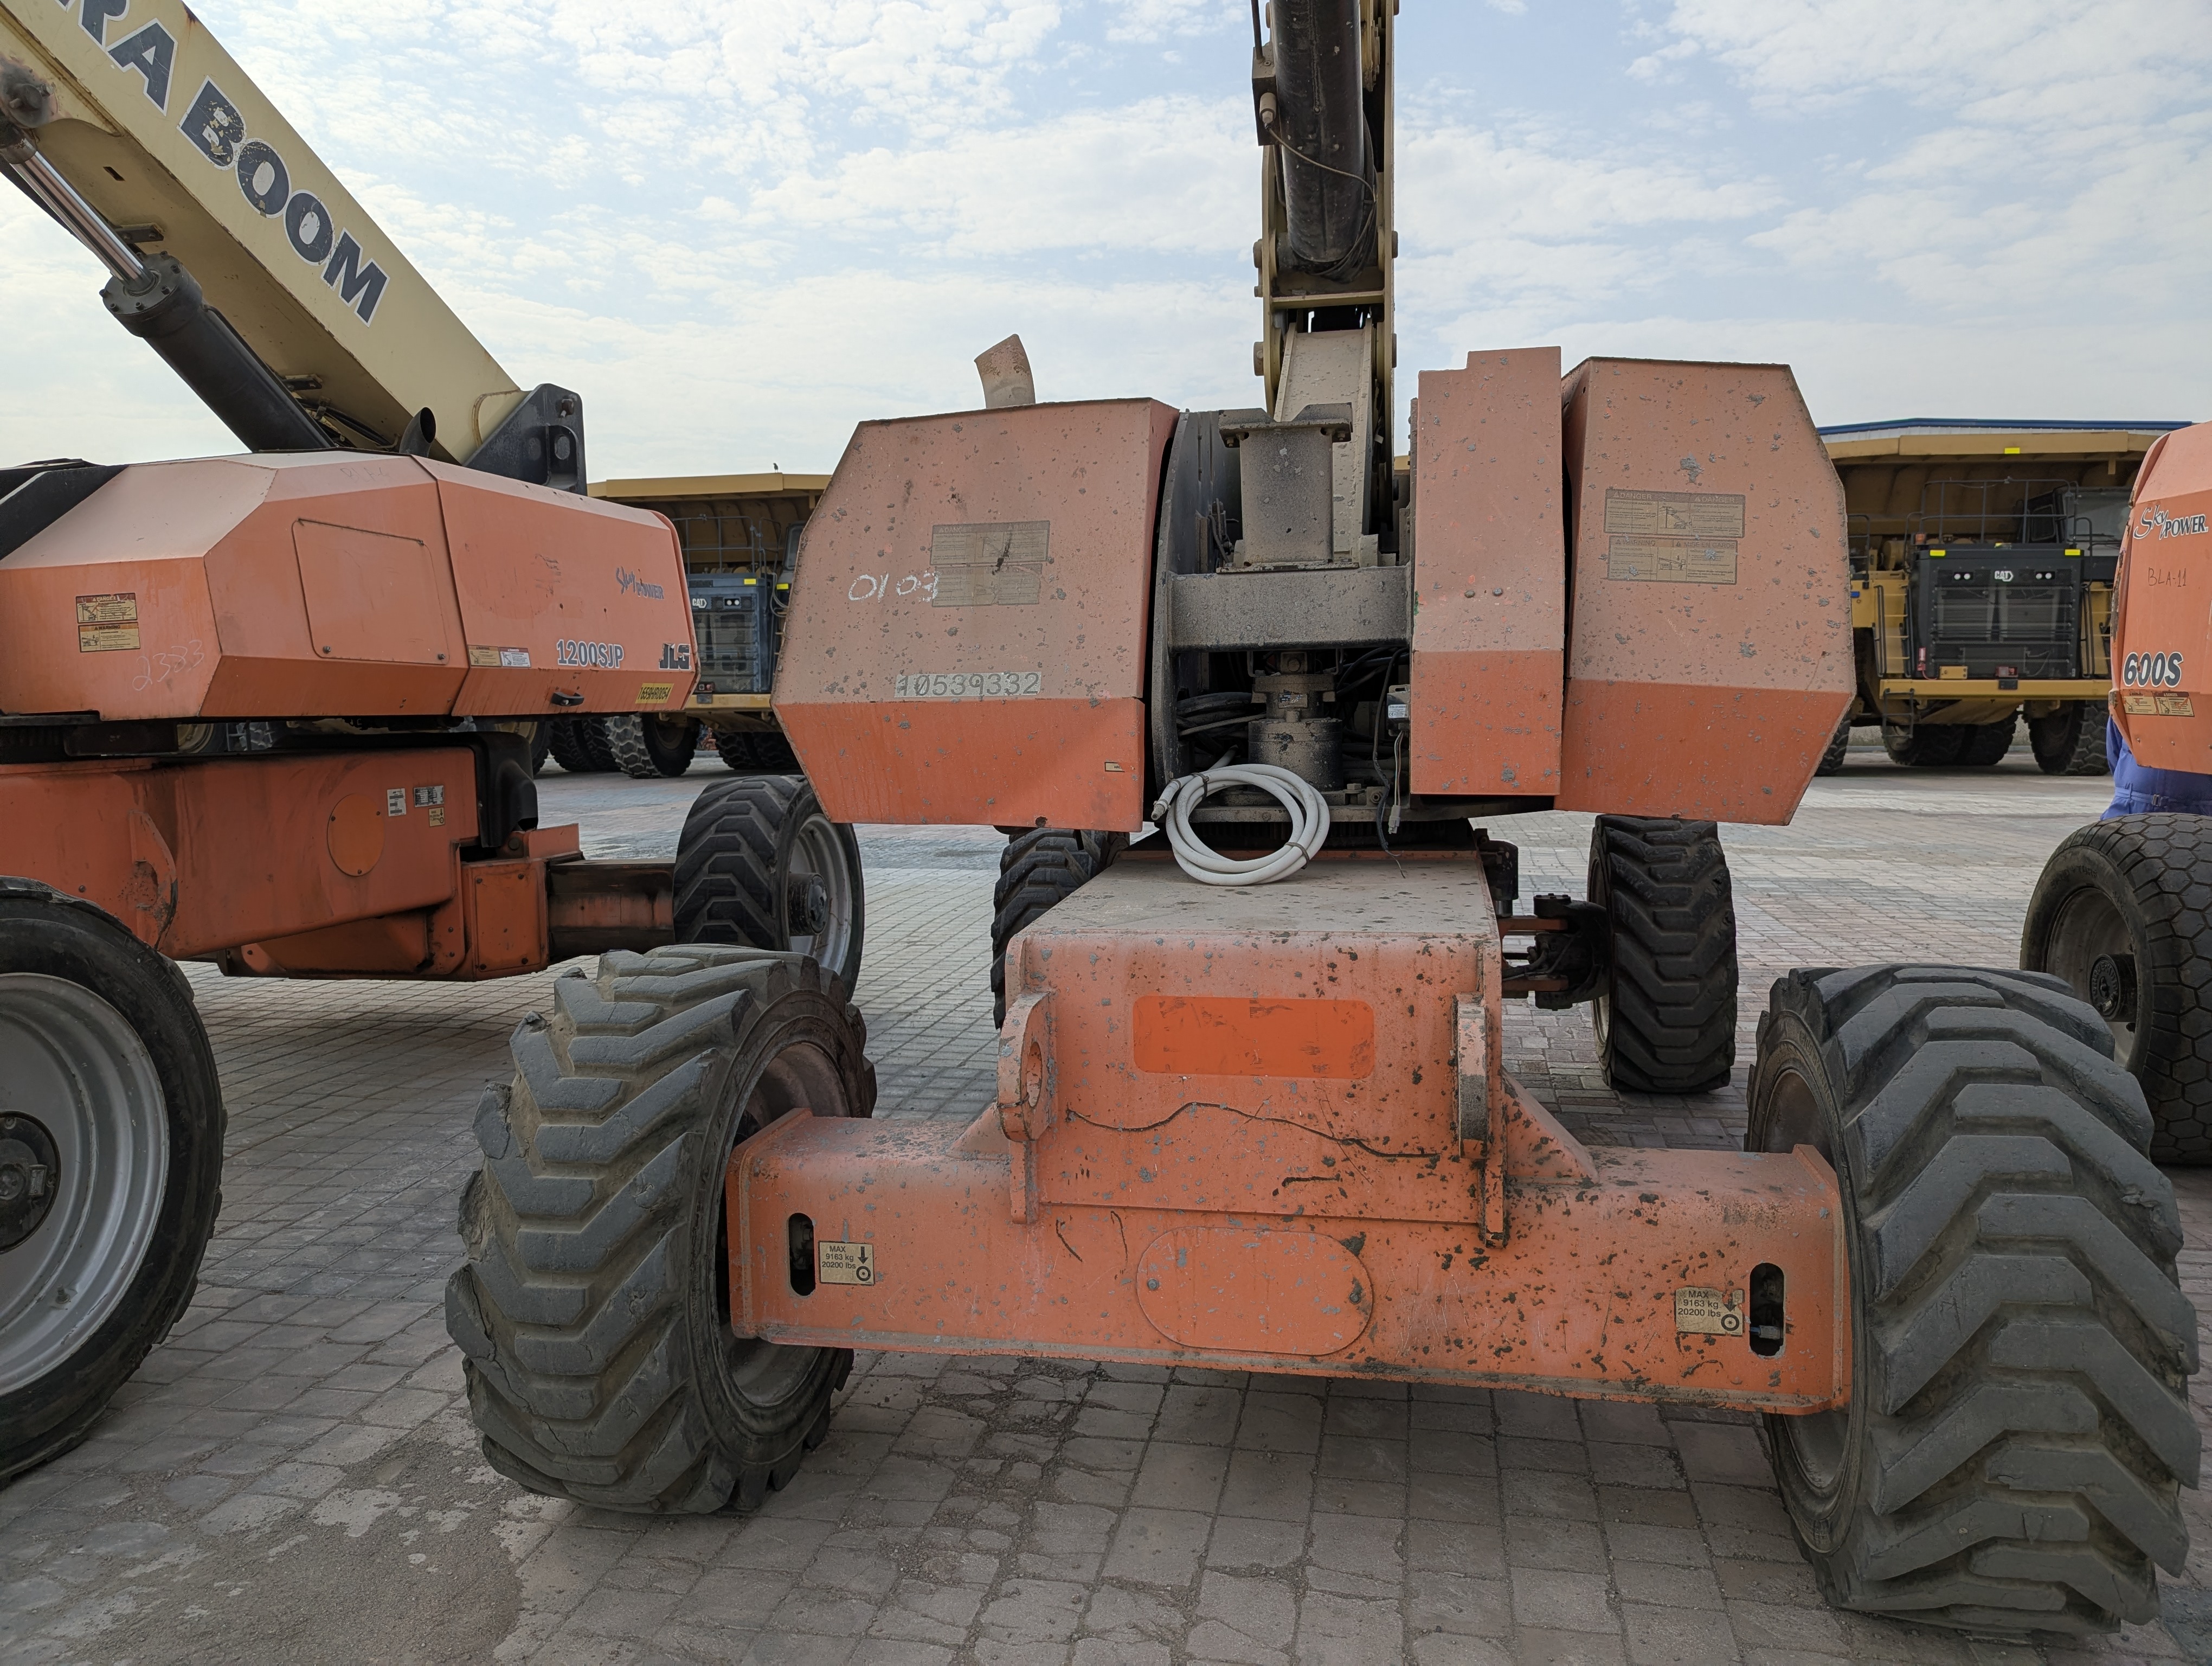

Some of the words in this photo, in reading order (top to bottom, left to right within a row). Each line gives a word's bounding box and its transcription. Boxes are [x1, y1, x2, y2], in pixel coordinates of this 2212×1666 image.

[177, 75, 390, 327] BOOM
[1994, 571, 2014, 582] CAT
[692, 598, 707, 608] CAT
[557, 639, 624, 668] 1200SJP
[659, 643, 692, 670] JLG
[2123, 651, 2183, 688] 600S
[896, 672, 1039, 696] 10539332
[845, 1254, 854, 1262] kg
[1678, 1308, 1705, 1316] 20200
[1708, 1300, 1719, 1309] kg
